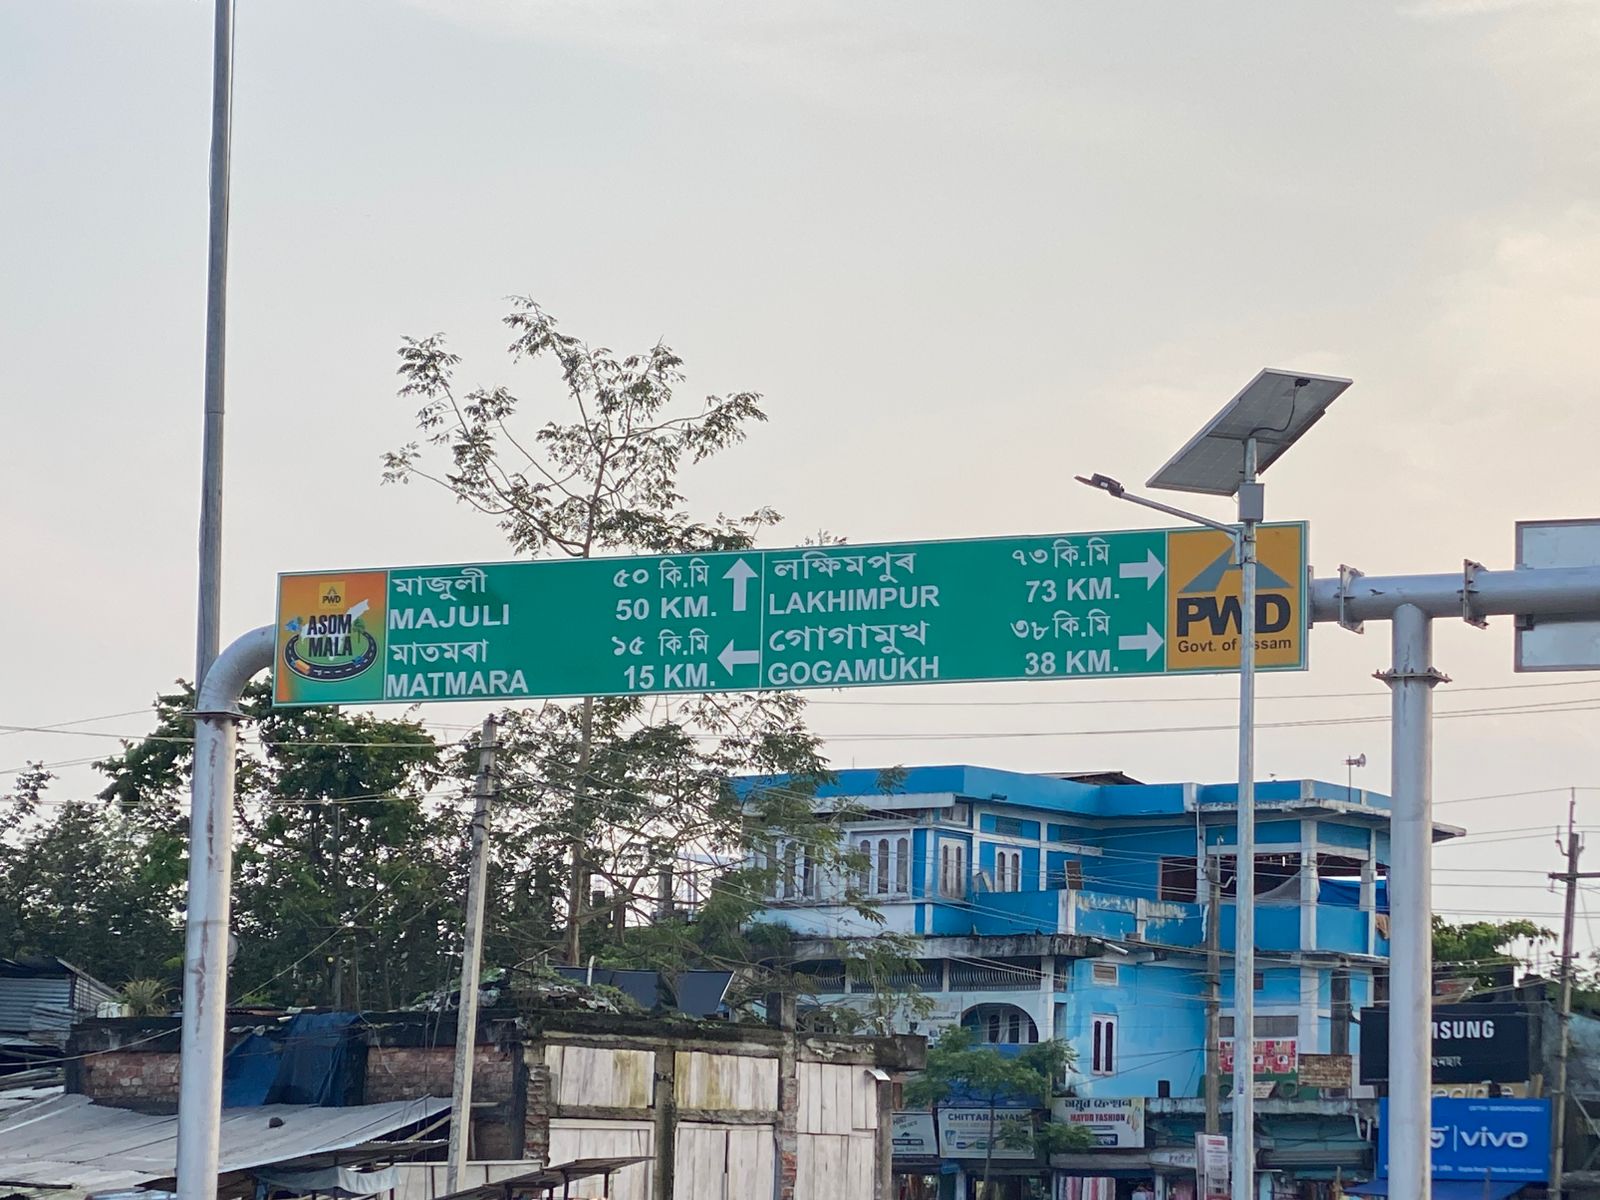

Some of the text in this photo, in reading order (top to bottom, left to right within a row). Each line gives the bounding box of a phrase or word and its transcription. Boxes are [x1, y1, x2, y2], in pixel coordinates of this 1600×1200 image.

[1012, 550, 1048, 566] ৭৩
[392, 568, 488, 600] মাজুলী
[613, 568, 649, 588] ৫০
[769, 577, 1120, 615] LAKHIMPUR 73 KM.
[322, 595, 341, 604] PWD
[307, 613, 352, 635] ASOM
[390, 596, 717, 630] MAJULI 50 KM.
[1177, 594, 1291, 637] PWD
[308, 636, 353, 657] MALA
[389, 639, 489, 665] মাতমৰা
[611, 635, 645, 656] ১৫
[769, 620, 930, 655] গোগামুখ
[1010, 620, 1050, 640] ৩৮
[1178, 638, 1291, 653] Govt. of ssam
[768, 649, 1119, 684] GOGAMUKH 38 KM.
[387, 663, 716, 697] MATMARA 15 KM.
[1431, 1020, 1495, 1039] SUNG
[1095, 1113, 1126, 1121] FASHION
[1460, 1126, 1528, 1148] vivo
